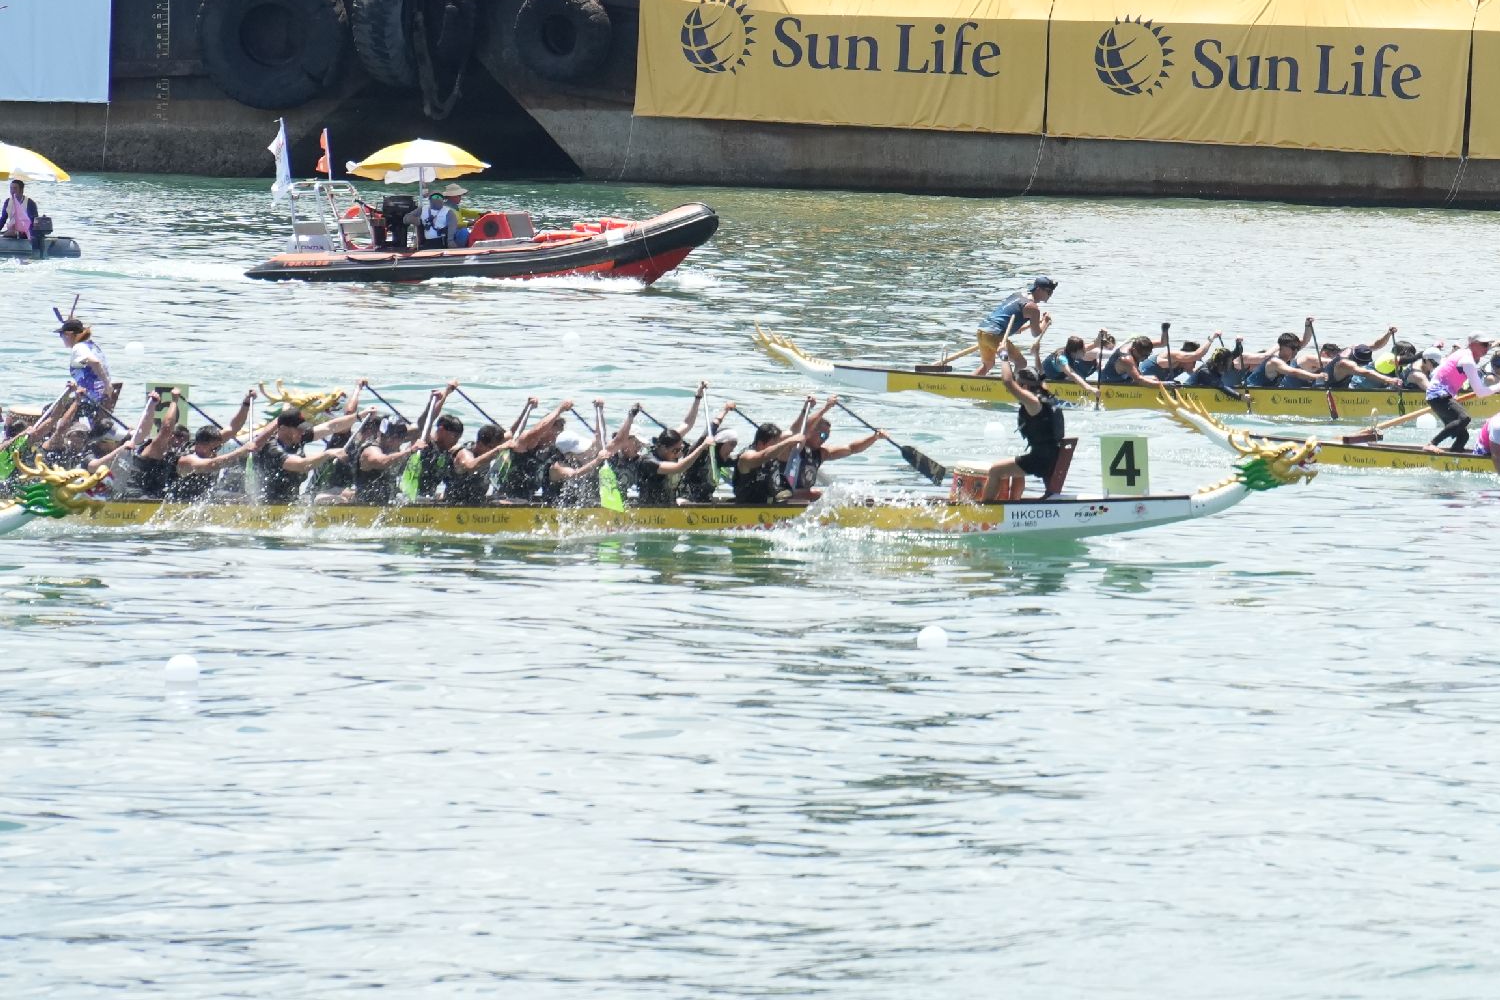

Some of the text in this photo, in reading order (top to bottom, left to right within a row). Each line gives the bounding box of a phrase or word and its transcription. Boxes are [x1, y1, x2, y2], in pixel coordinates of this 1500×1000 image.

[772, 17, 1001, 78] Sun Life
[1191, 39, 1422, 100] Sun Life
[1109, 440, 1141, 487] 4
[701, 514, 738, 524] Sun Life
[1011, 509, 1060, 519] HKCDBA
